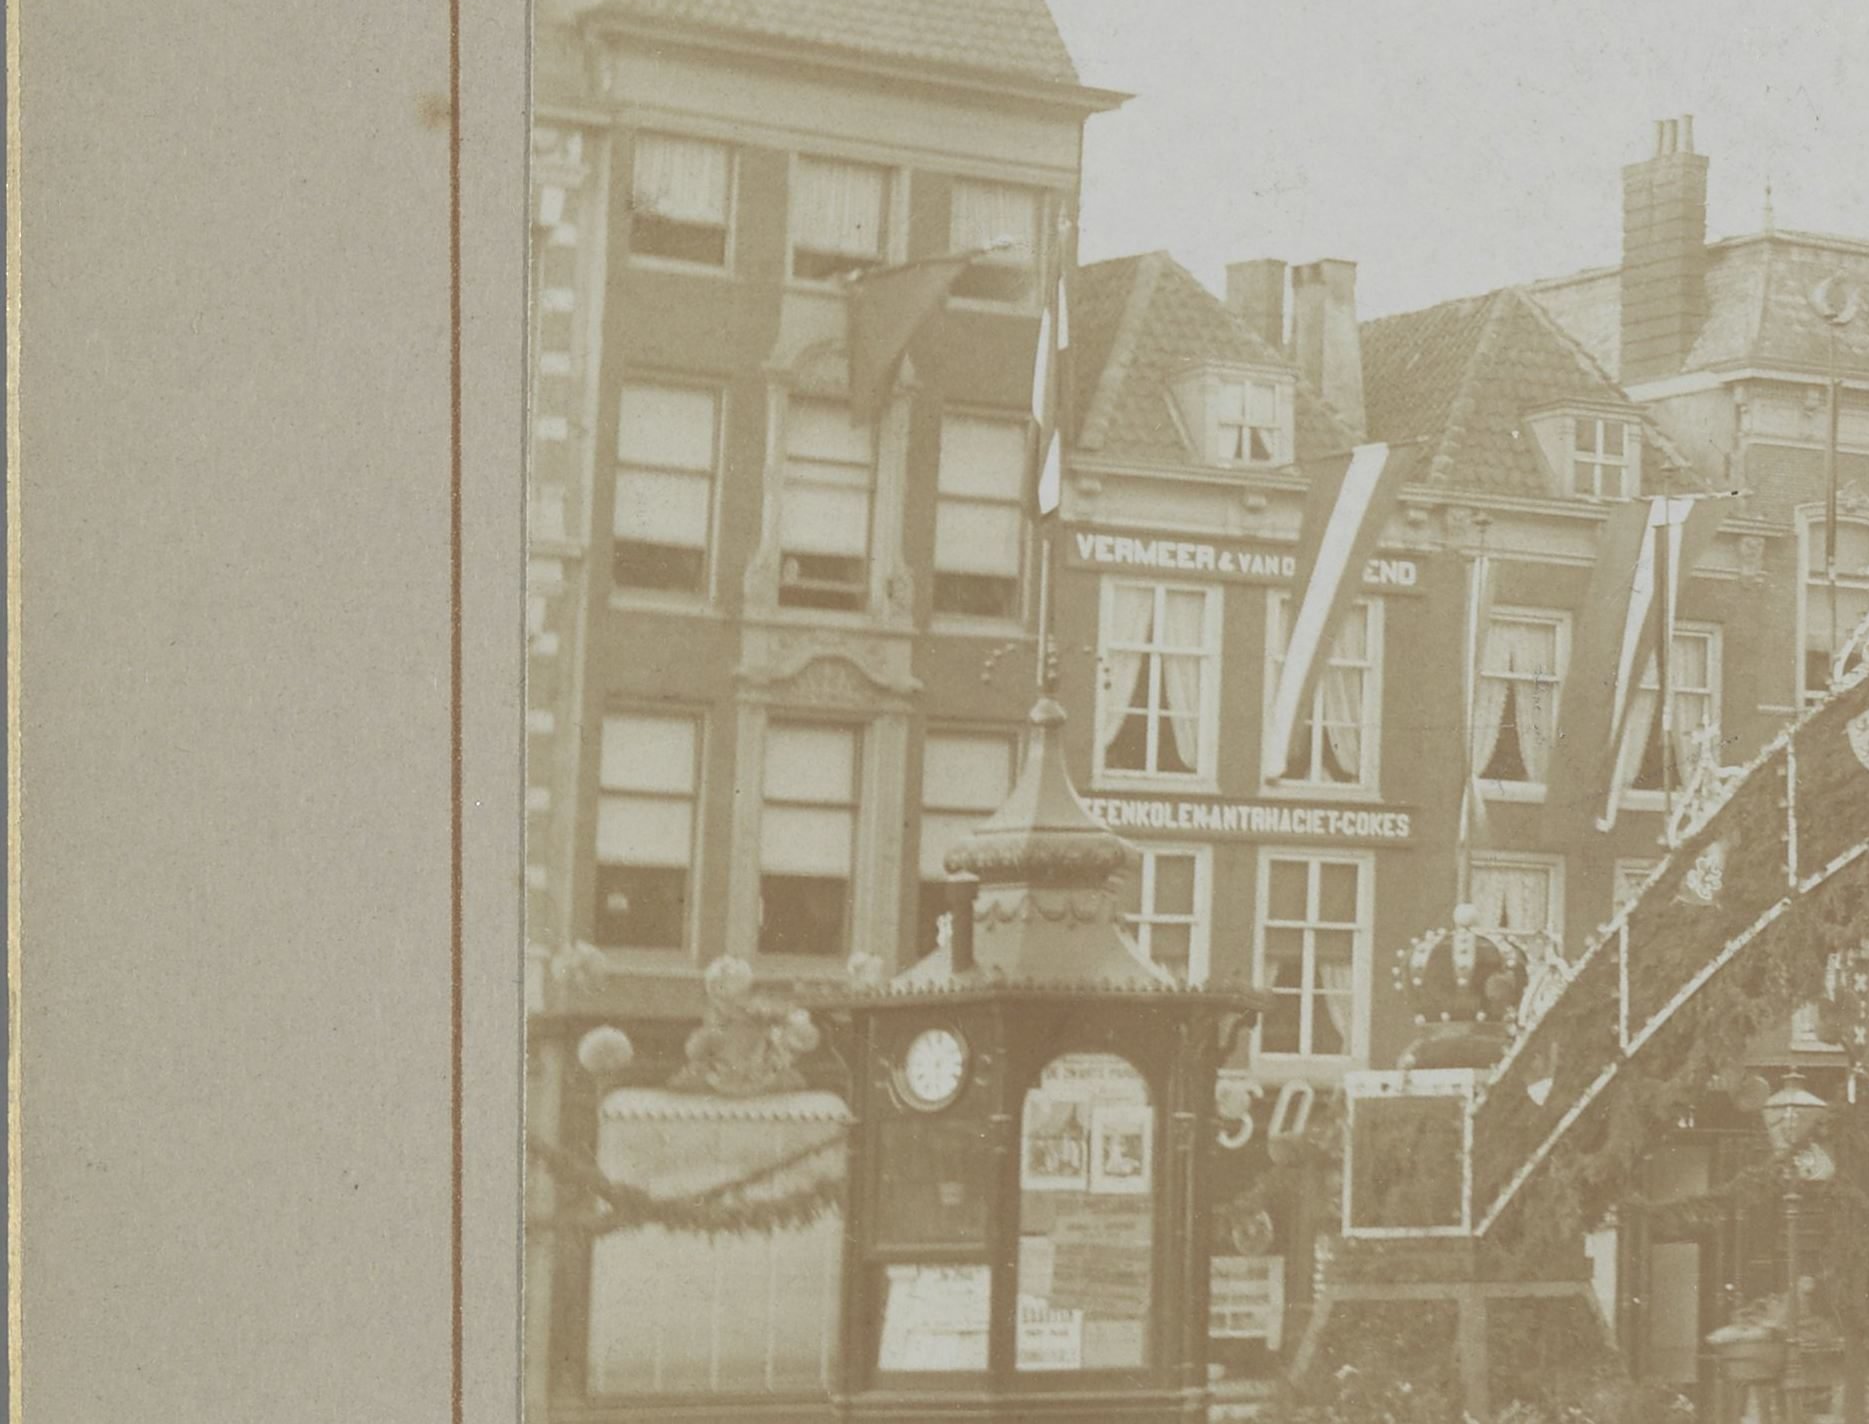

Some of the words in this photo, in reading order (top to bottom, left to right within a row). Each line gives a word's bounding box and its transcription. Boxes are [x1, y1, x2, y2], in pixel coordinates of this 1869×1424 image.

[1076, 532, 1215, 571] VERMEER
[1218, 550, 1235, 572] &
[1238, 551, 1280, 576] VAN
